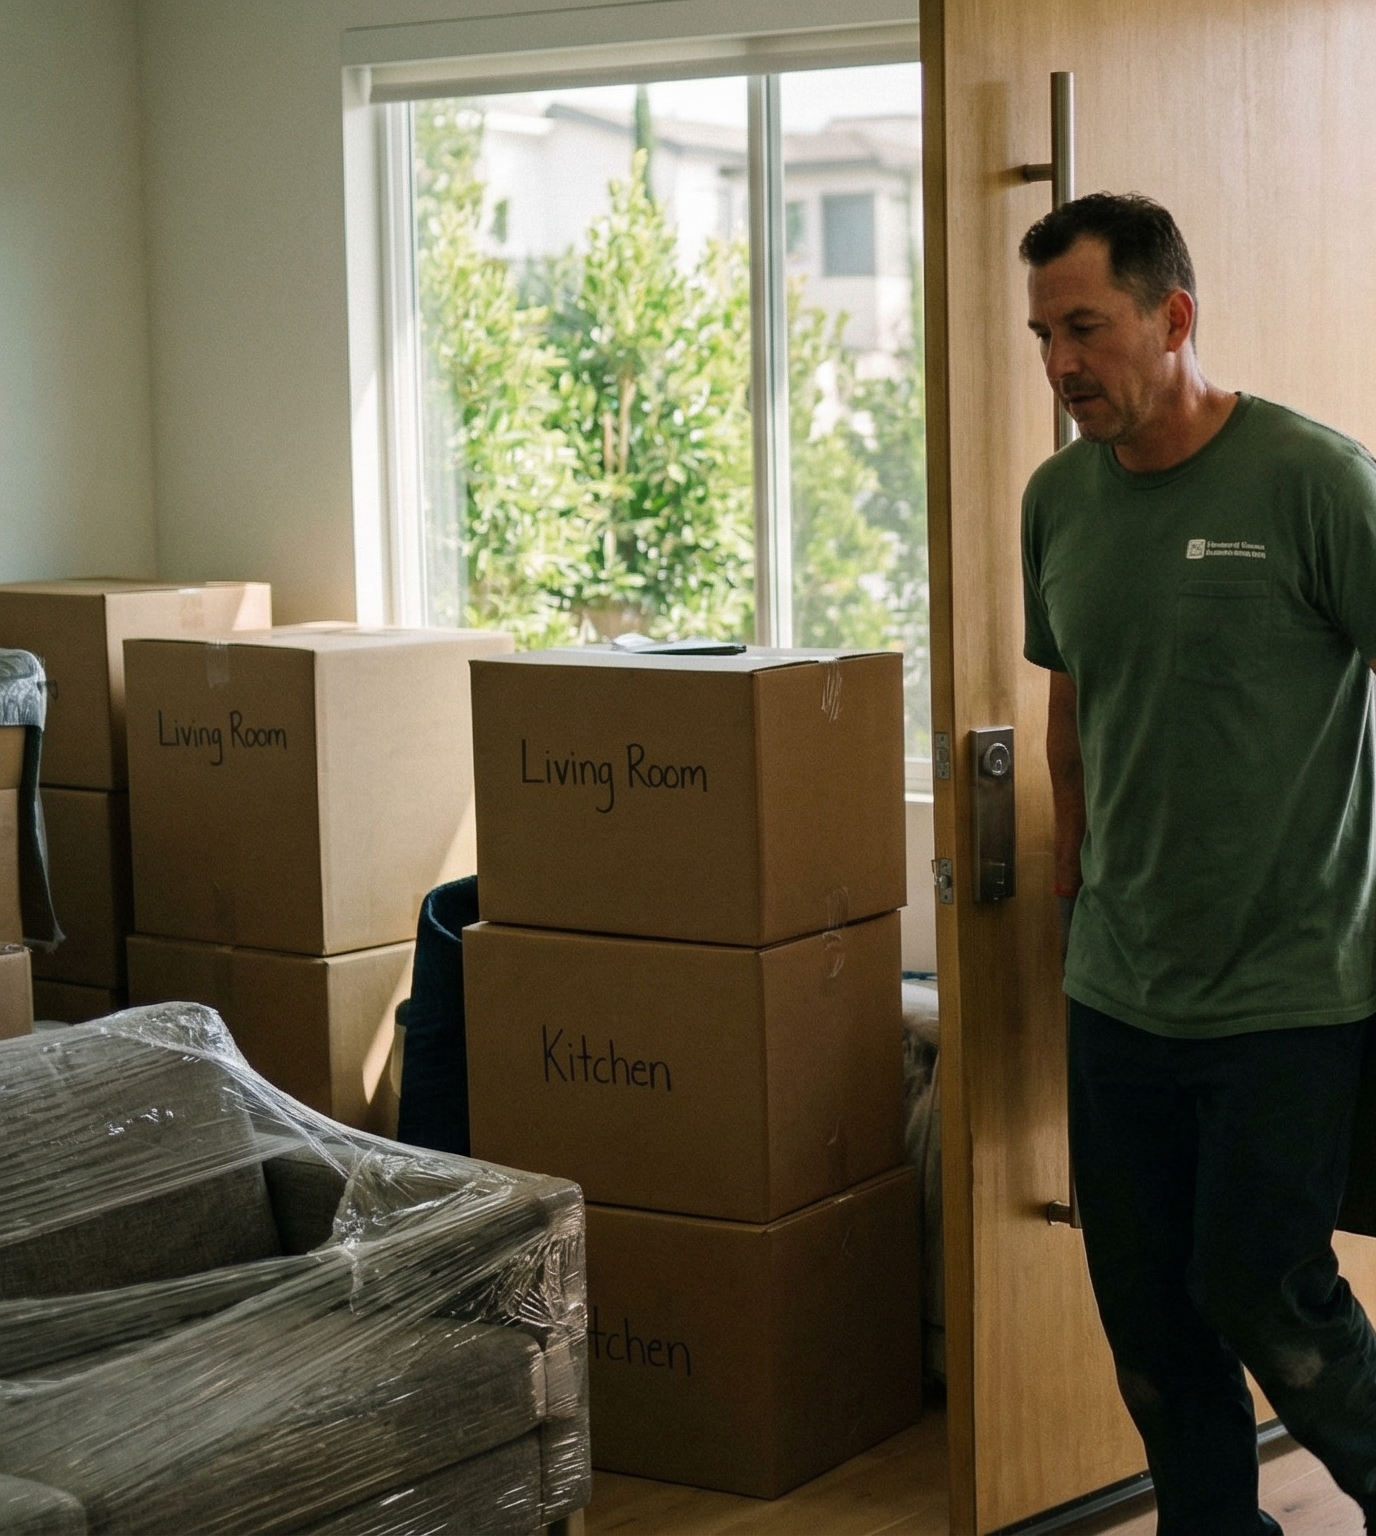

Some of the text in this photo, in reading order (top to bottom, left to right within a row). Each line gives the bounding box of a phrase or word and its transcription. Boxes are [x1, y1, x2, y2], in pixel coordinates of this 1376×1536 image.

[158, 710, 288, 767] Living Room
[521, 739, 709, 814] Living Room
[542, 1024, 673, 1093] Kitchen
[589, 1305, 692, 1377] tchen
